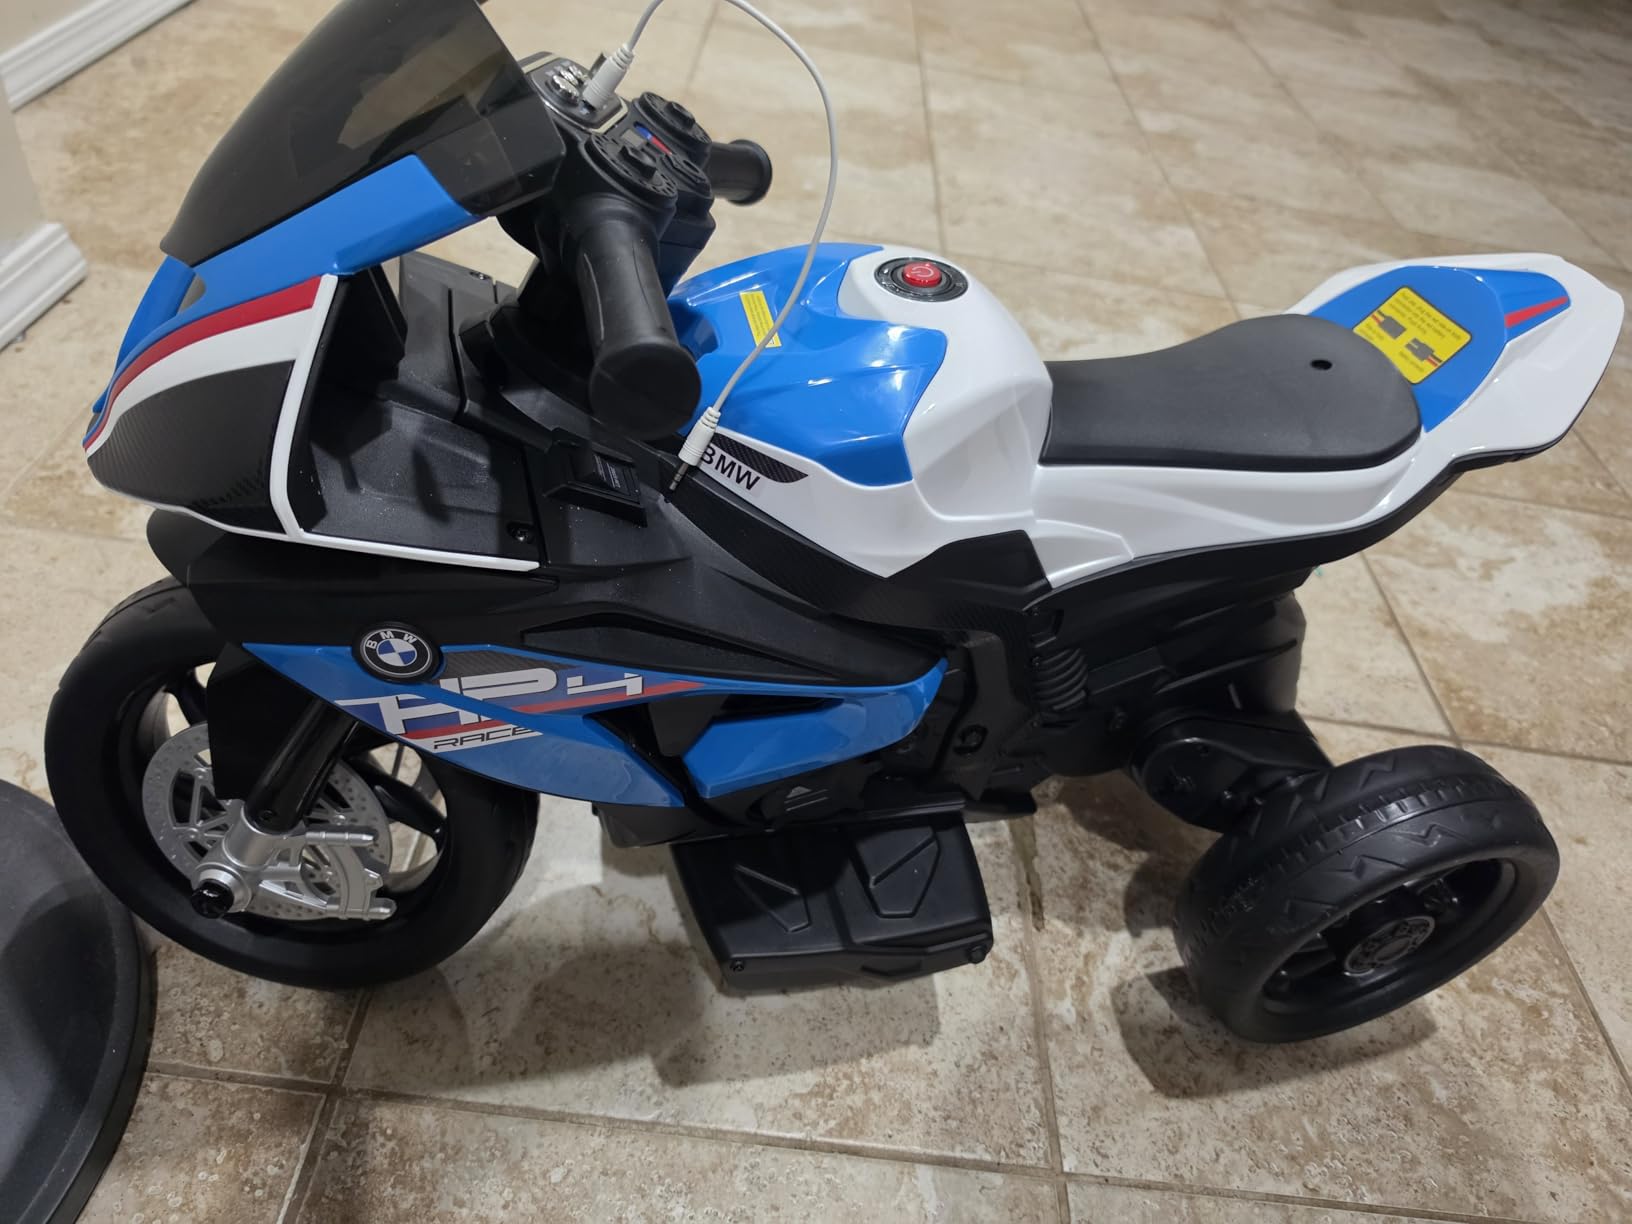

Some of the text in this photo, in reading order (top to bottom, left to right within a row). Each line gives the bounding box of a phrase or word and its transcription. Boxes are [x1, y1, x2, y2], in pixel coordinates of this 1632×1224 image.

[700, 446, 760, 489] BMW
[366, 630, 418, 650] BMW
[433, 726, 535, 750] RACE
